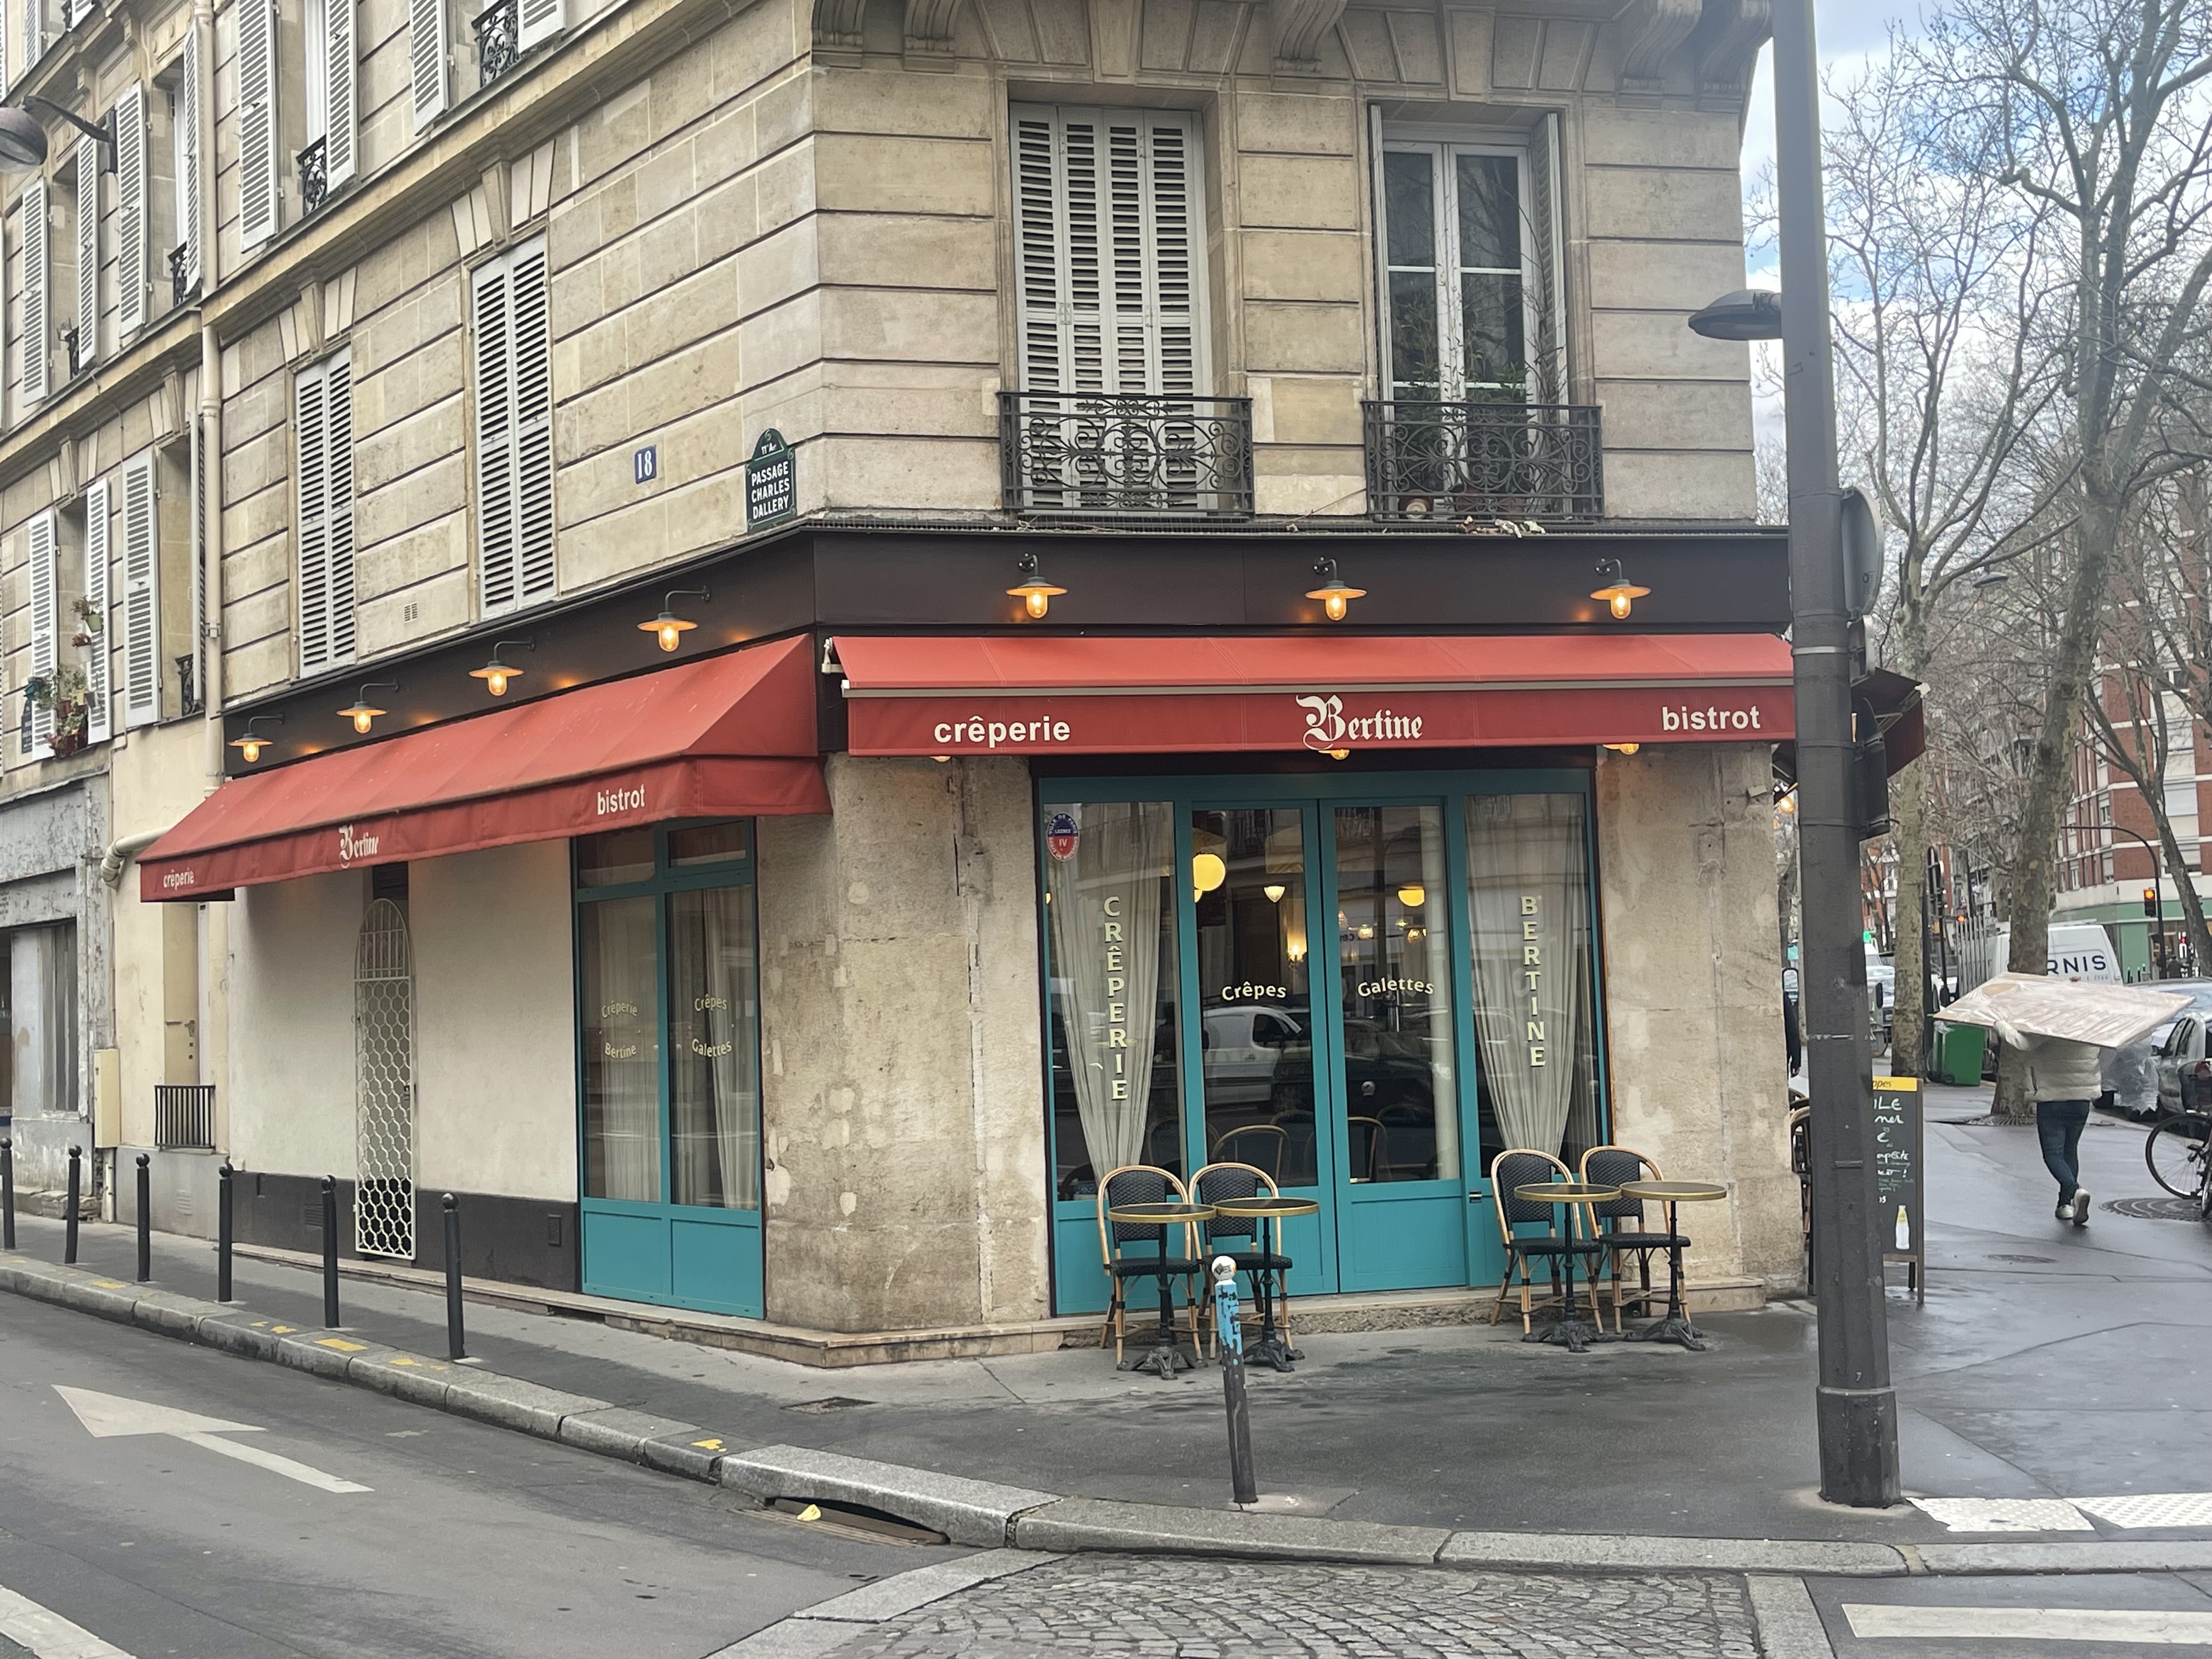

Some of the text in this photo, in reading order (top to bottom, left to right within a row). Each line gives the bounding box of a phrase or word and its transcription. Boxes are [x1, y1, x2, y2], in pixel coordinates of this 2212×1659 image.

[637, 450, 653, 479] 18
[751, 461, 789, 487] PASSAGE
[751, 478, 790, 503] CHARLES
[753, 494, 789, 520] DALLERY
[934, 695, 1761, 751] crêperie Bertine bistrot
[163, 783, 645, 891] crêperie Bertine bistrot
[1059, 838, 1068, 847] IV
[1221, 977, 1435, 1001] Crêpes Galettes
[1520, 896, 1546, 1067] BERTINE
[694, 993, 727, 1012] Crêpes
[1103, 896, 1128, 1101] CRÊPERIE
[604, 1042, 637, 1059] Bertine
[691, 1038, 732, 1057] Galettes
